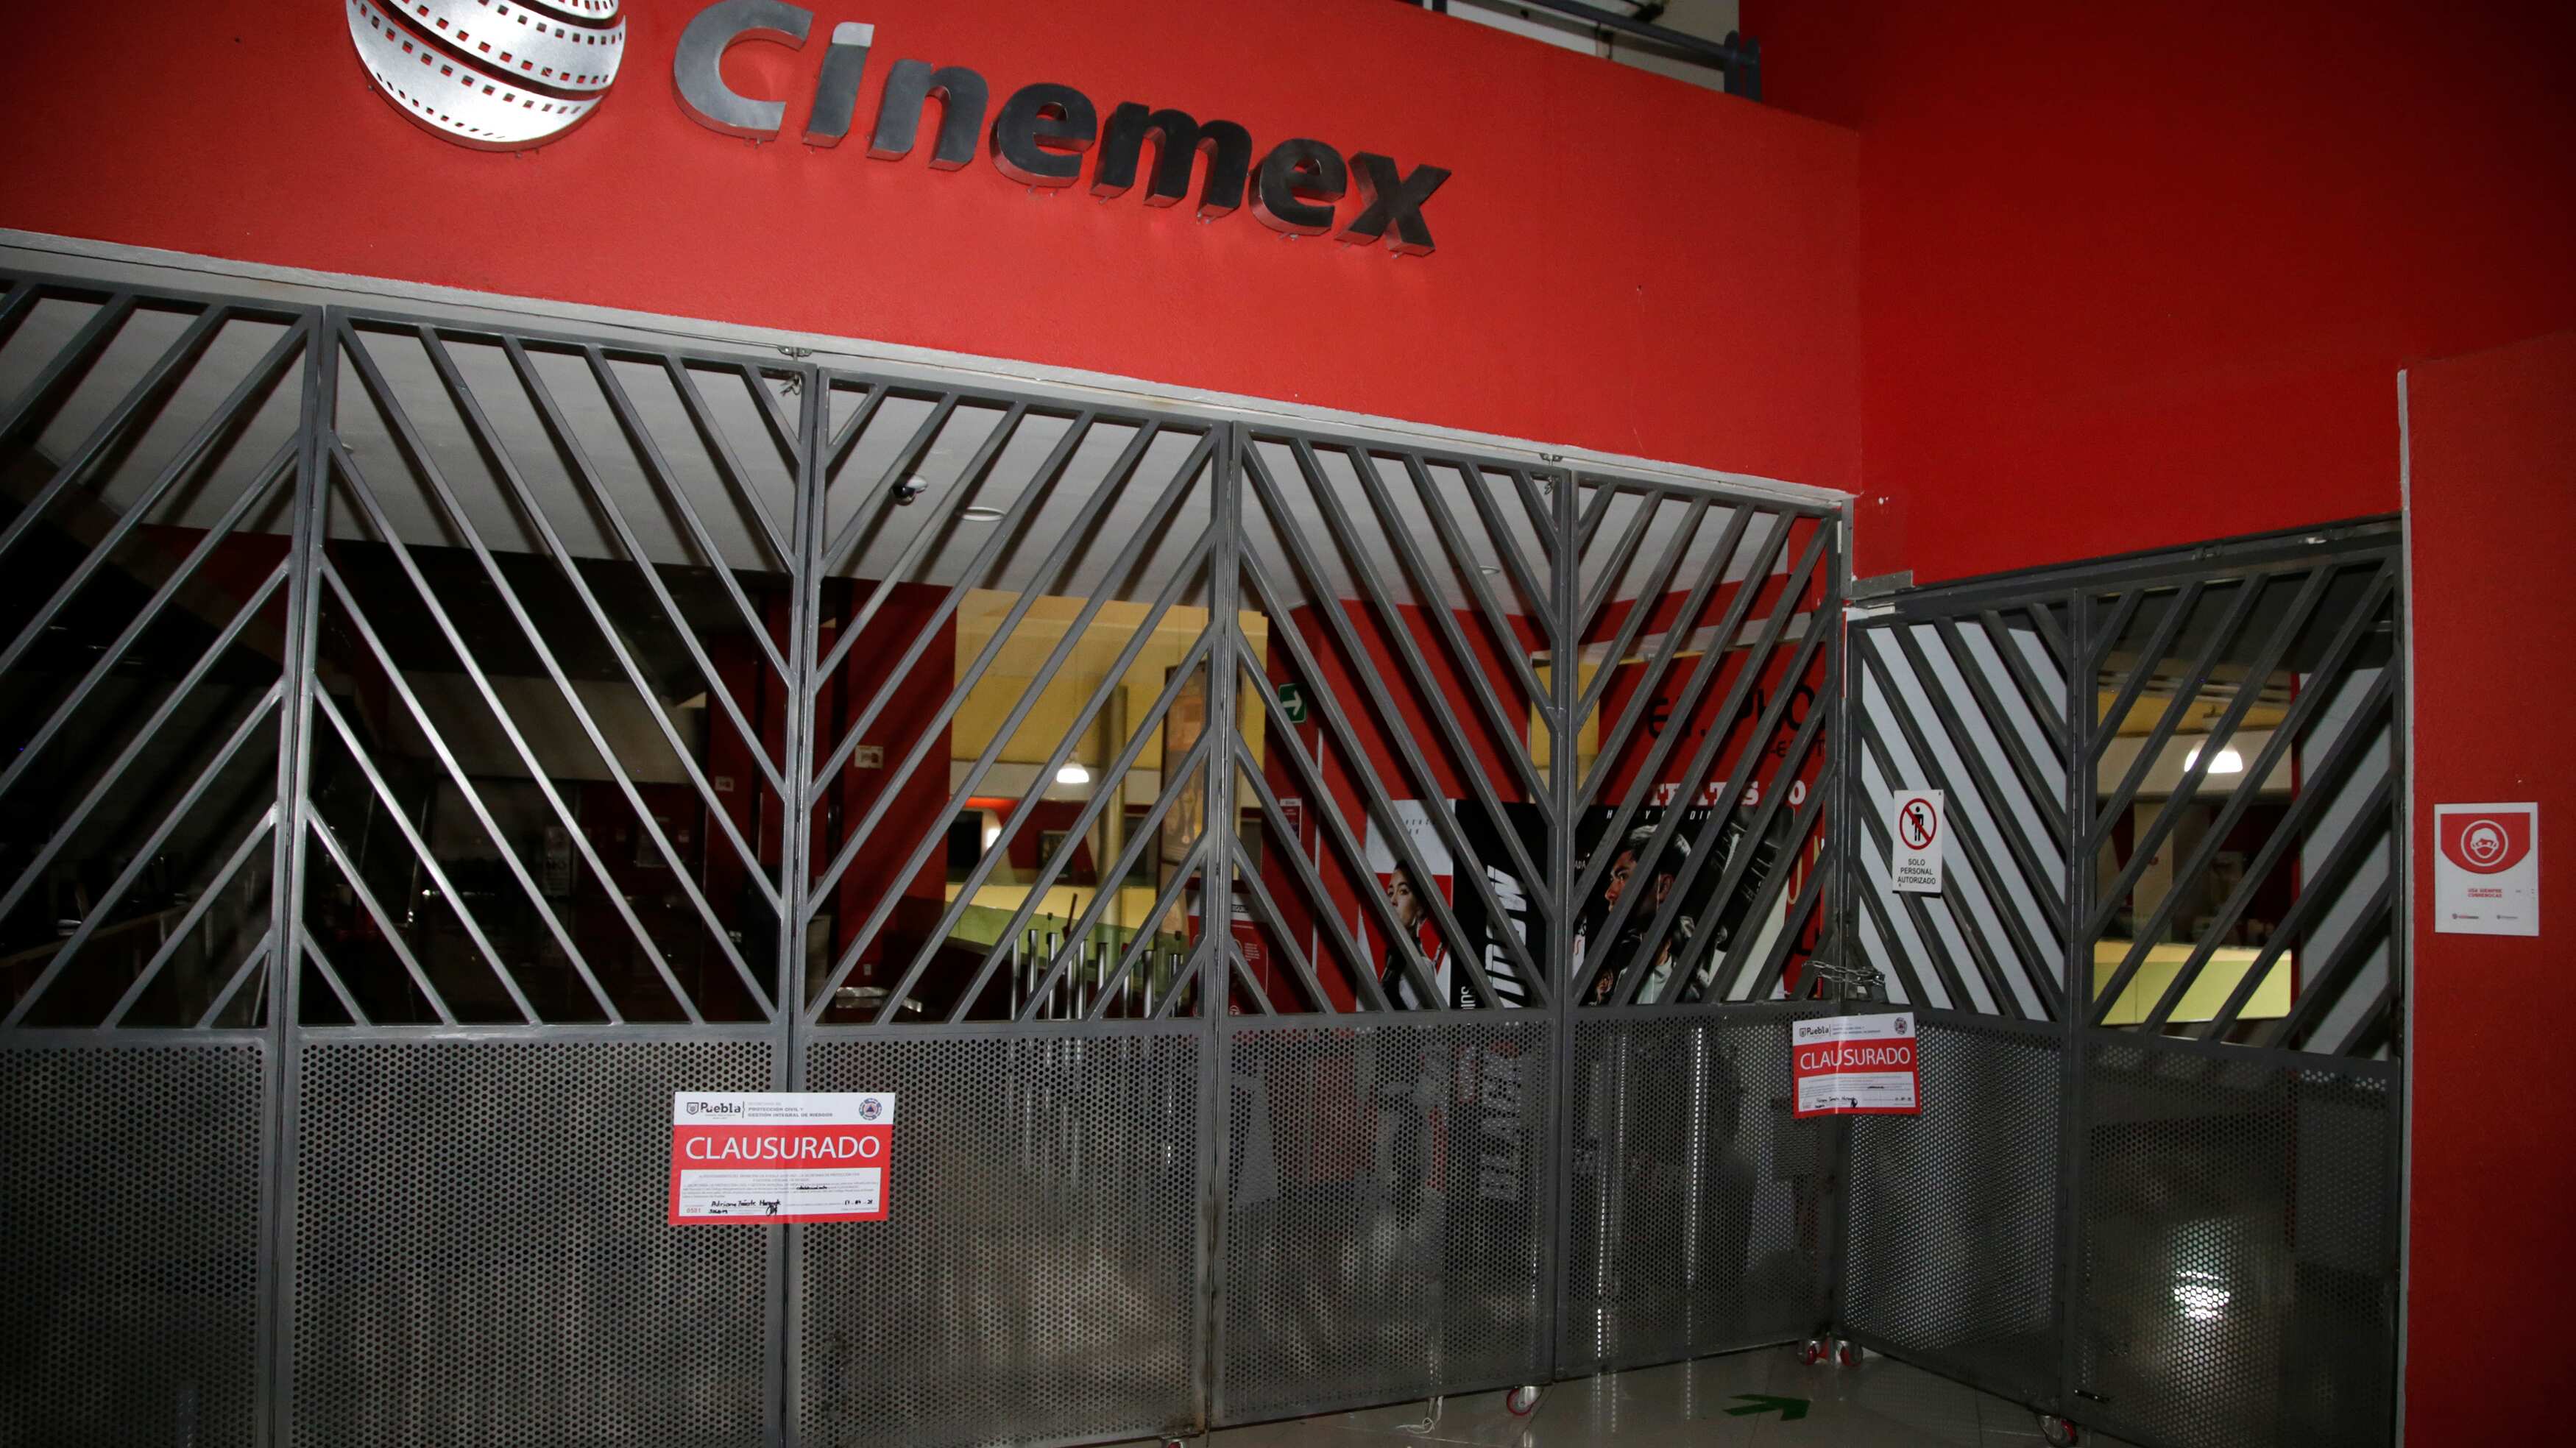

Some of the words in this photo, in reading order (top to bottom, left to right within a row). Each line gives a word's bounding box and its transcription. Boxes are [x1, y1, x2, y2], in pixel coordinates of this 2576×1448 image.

[673, 0, 1452, 256] Cinemex
[1908, 858, 1925, 866] SOLO
[1900, 867, 1933, 875] PERSONAL
[1897, 876, 1936, 884] AUTORIZADO
[1807, 1026, 1829, 1035] Puebla
[1800, 1047, 1911, 1070] CLAUSURADO
[700, 1101, 741, 1113] Puebla
[685, 1136, 880, 1160] CLAUSURADO
